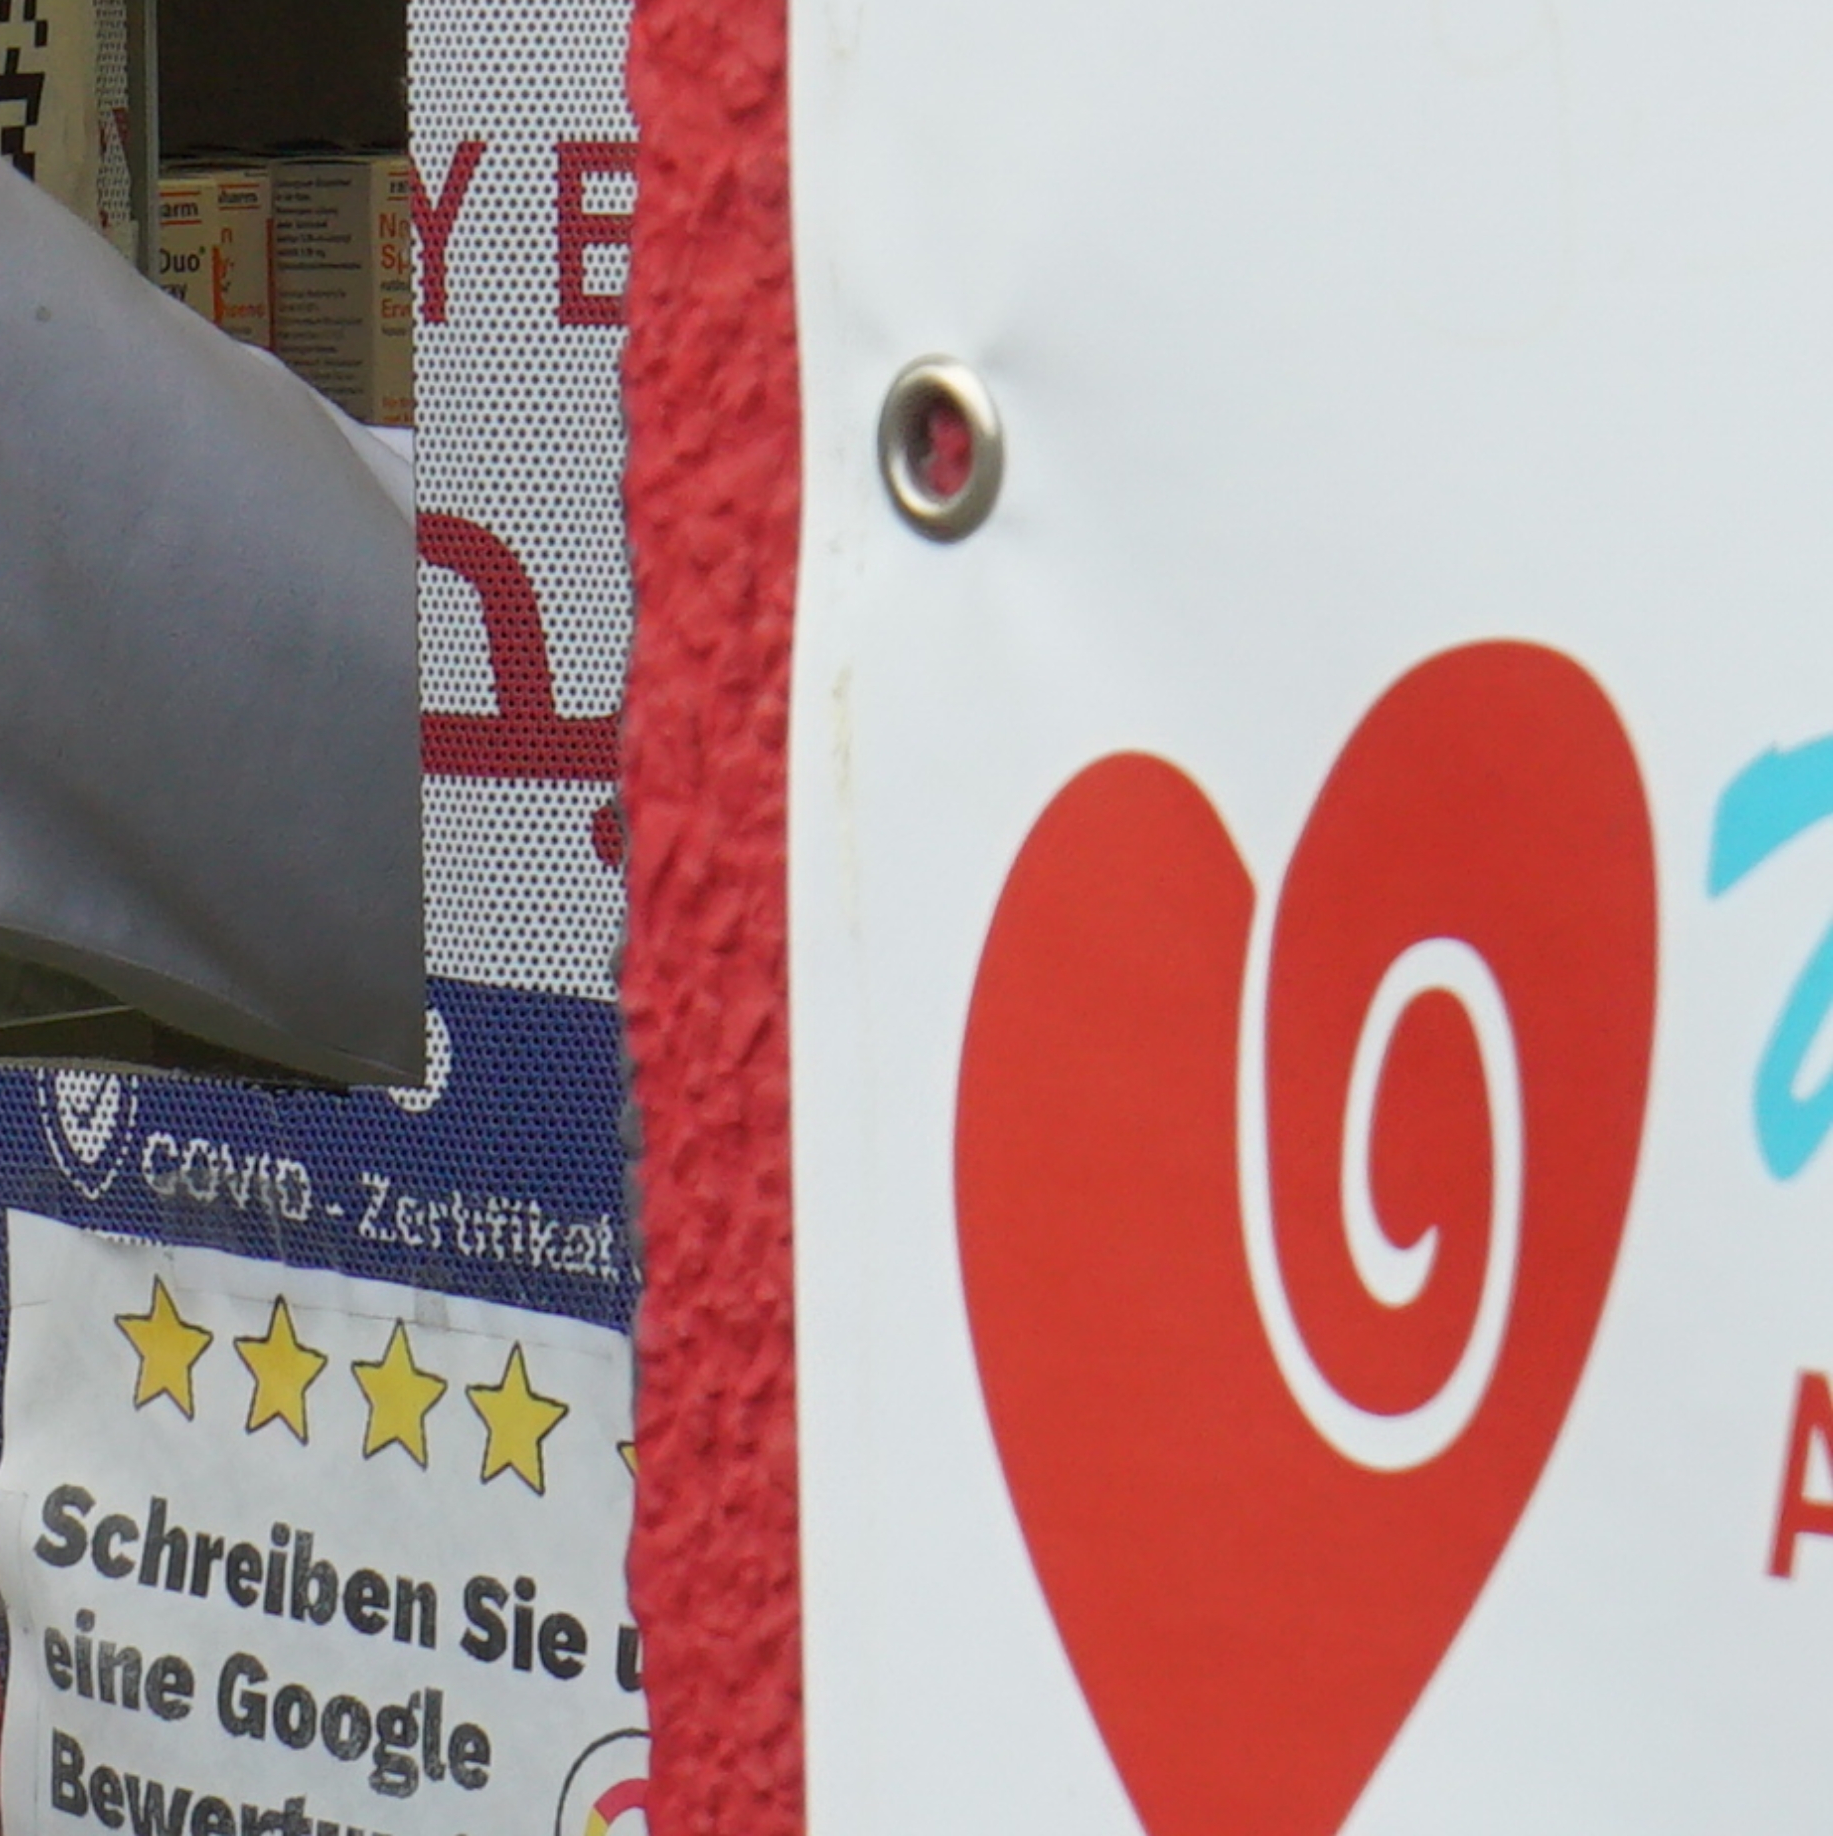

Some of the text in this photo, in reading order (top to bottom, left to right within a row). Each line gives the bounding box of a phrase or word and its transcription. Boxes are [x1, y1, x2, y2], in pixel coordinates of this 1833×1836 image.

[142, 1131, 314, 1222] COVID
[33, 1481, 439, 1651] Schreiben
[459, 1572, 589, 1683] Sie
[44, 1608, 493, 1800] eine Google
